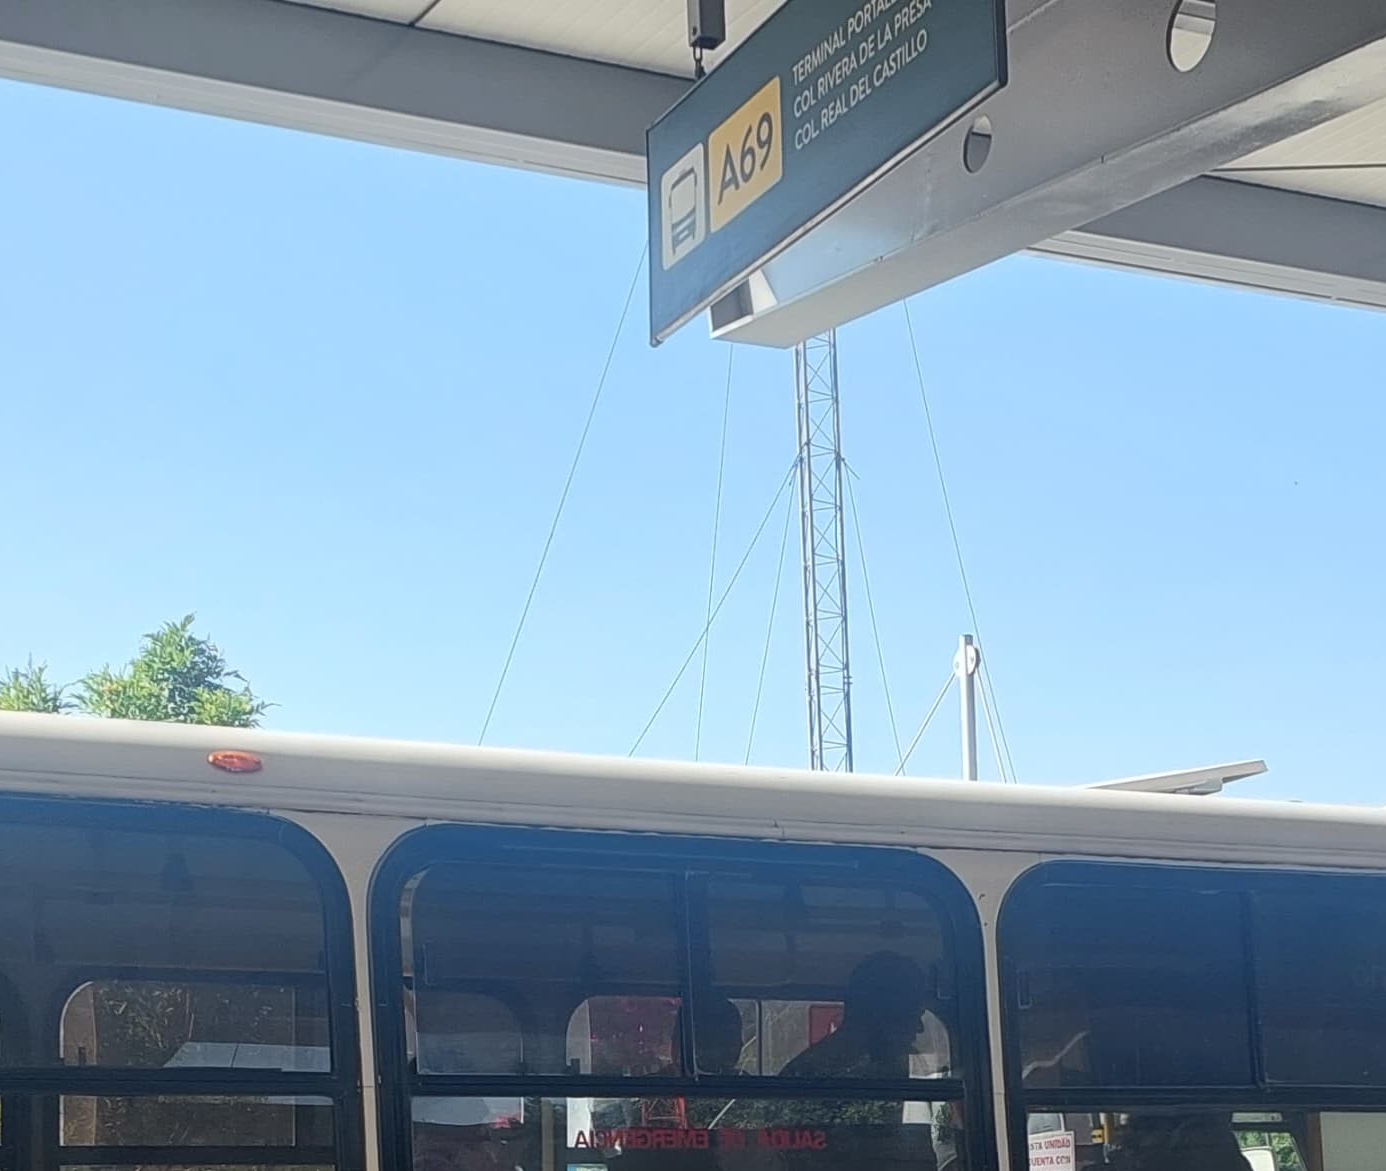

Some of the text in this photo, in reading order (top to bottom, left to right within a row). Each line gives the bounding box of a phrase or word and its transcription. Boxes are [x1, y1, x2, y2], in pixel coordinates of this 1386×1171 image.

[792, 0, 897, 86] TERMINAL PORTA
[793, 85, 817, 118] COL
[817, 51, 858, 100] RIVERA
[859, 34, 875, 65] DE
[877, 22, 893, 50] LA
[820, 93, 849, 130] REAL
[849, 74, 872, 108] DEL
[873, 28, 928, 87] CASTILLO
[717, 111, 773, 206] A69
[1029, 1156, 1054, 1167] UENTA
